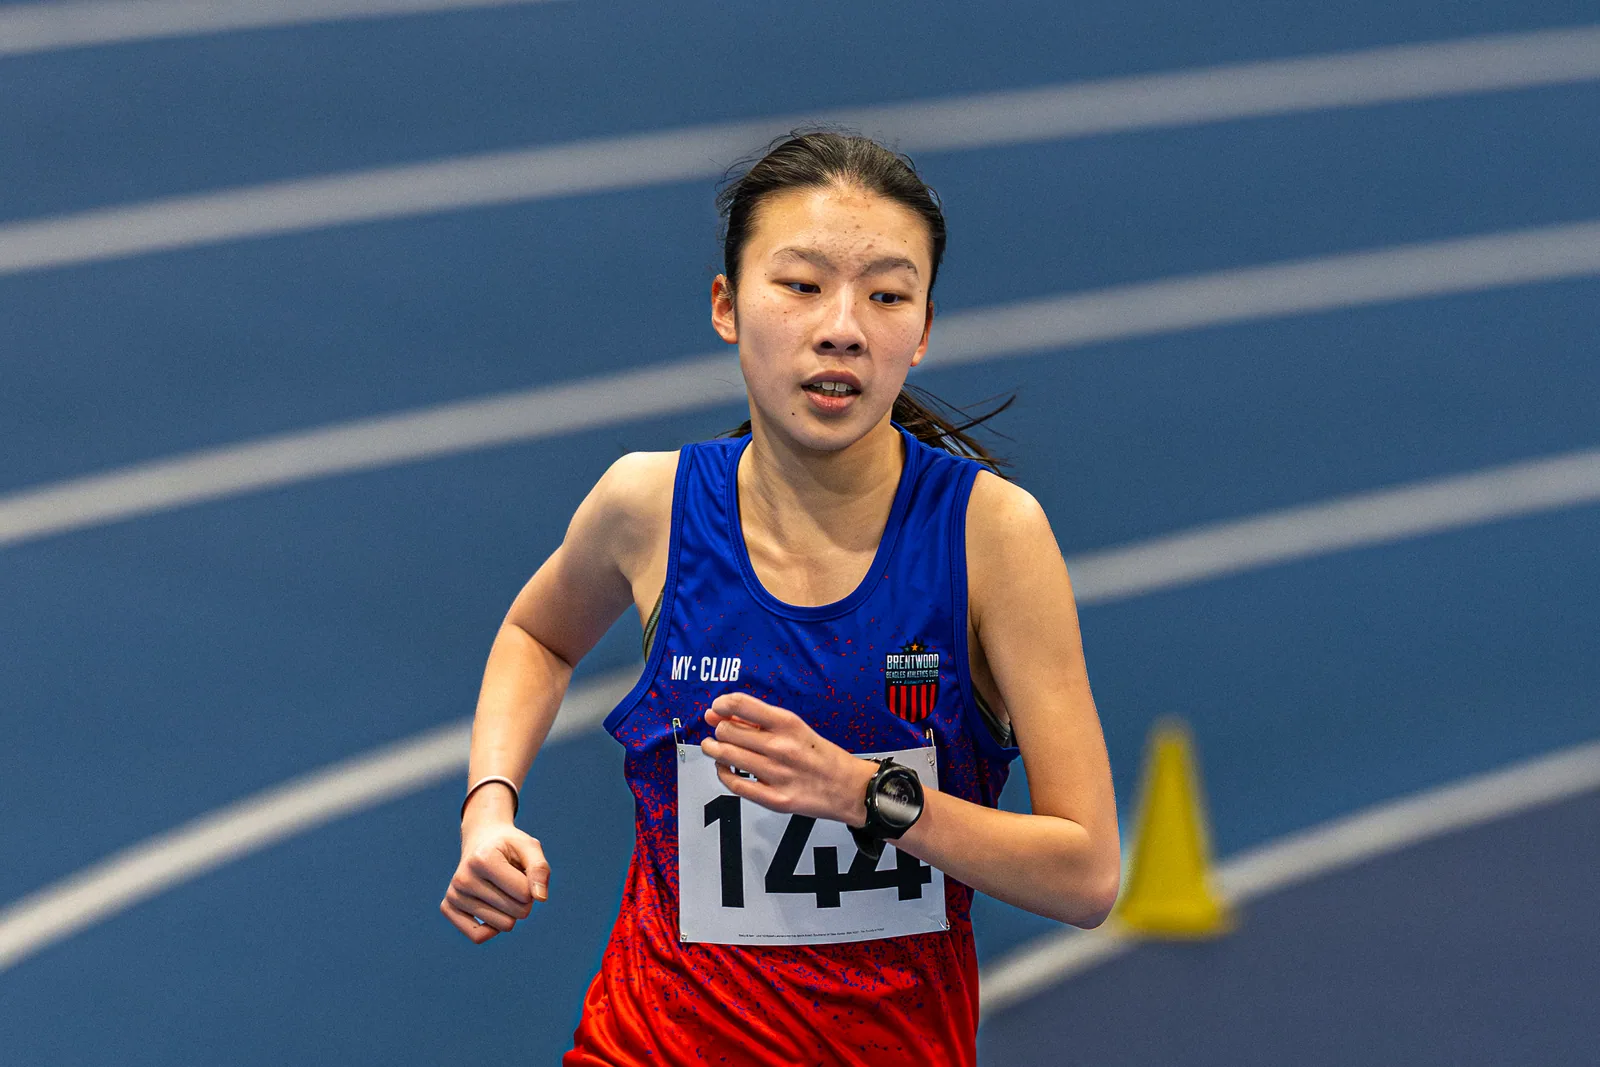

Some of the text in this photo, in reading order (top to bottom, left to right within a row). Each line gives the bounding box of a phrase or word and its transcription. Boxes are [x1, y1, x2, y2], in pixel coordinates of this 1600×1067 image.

[700, 656, 741, 682] CLUB
[886, 653, 939, 670] BRENTWOOD
[886, 669, 939, 679] BEAGLES ATHLETICS CLUB
